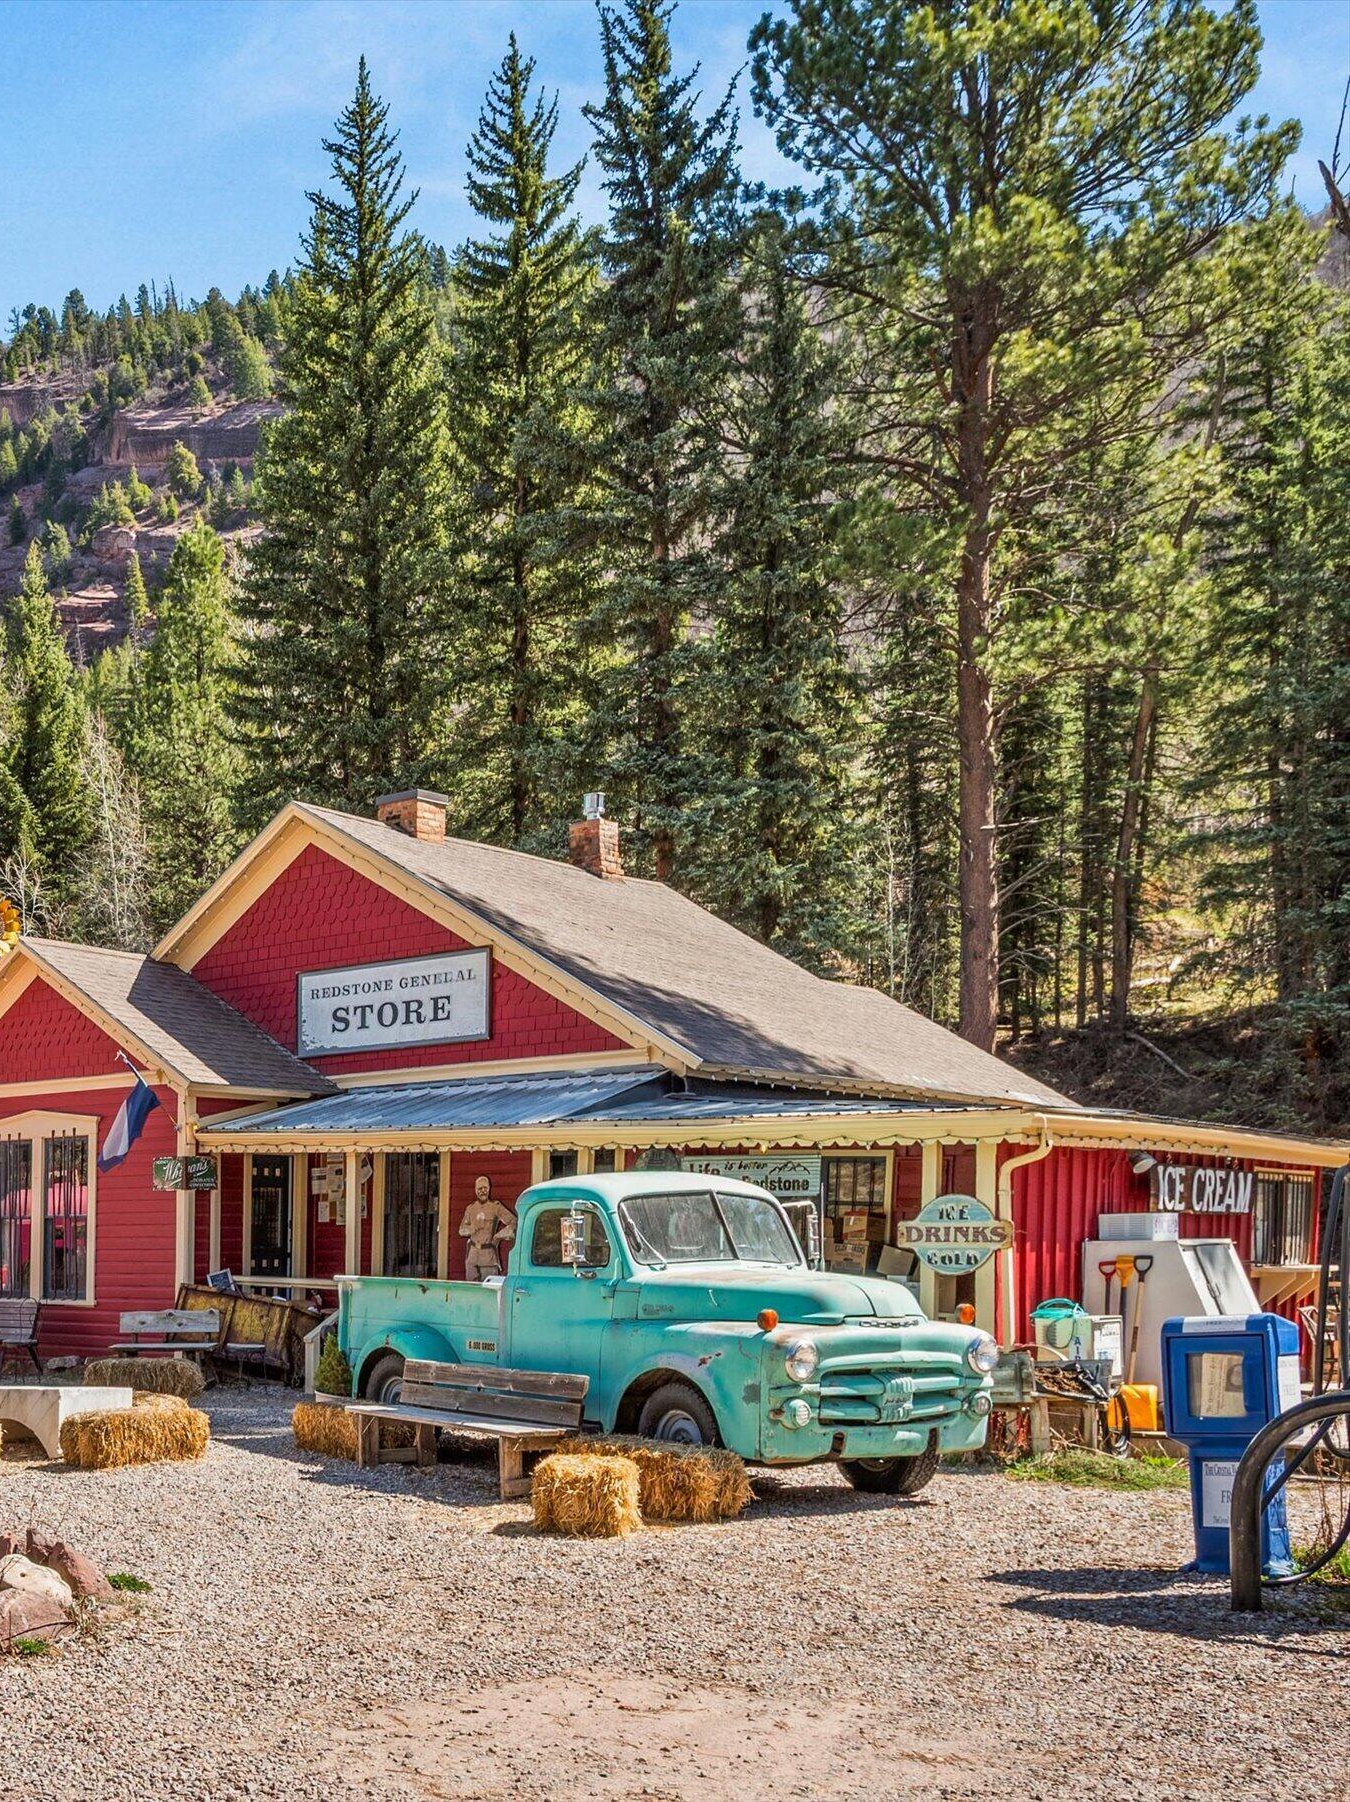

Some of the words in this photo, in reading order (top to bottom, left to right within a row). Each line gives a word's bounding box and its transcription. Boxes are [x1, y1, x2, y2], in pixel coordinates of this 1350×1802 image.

[311, 979, 394, 1000] REDSTONE
[399, 968, 477, 990] GENERAL
[332, 995, 452, 1034] STORE
[1156, 1165, 1187, 1211] ICE
[1192, 1168, 1253, 1214] CREAM
[937, 1204, 970, 1221] ICE
[904, 1225, 1009, 1243] DRINKS
[926, 1252, 980, 1266] COLD
